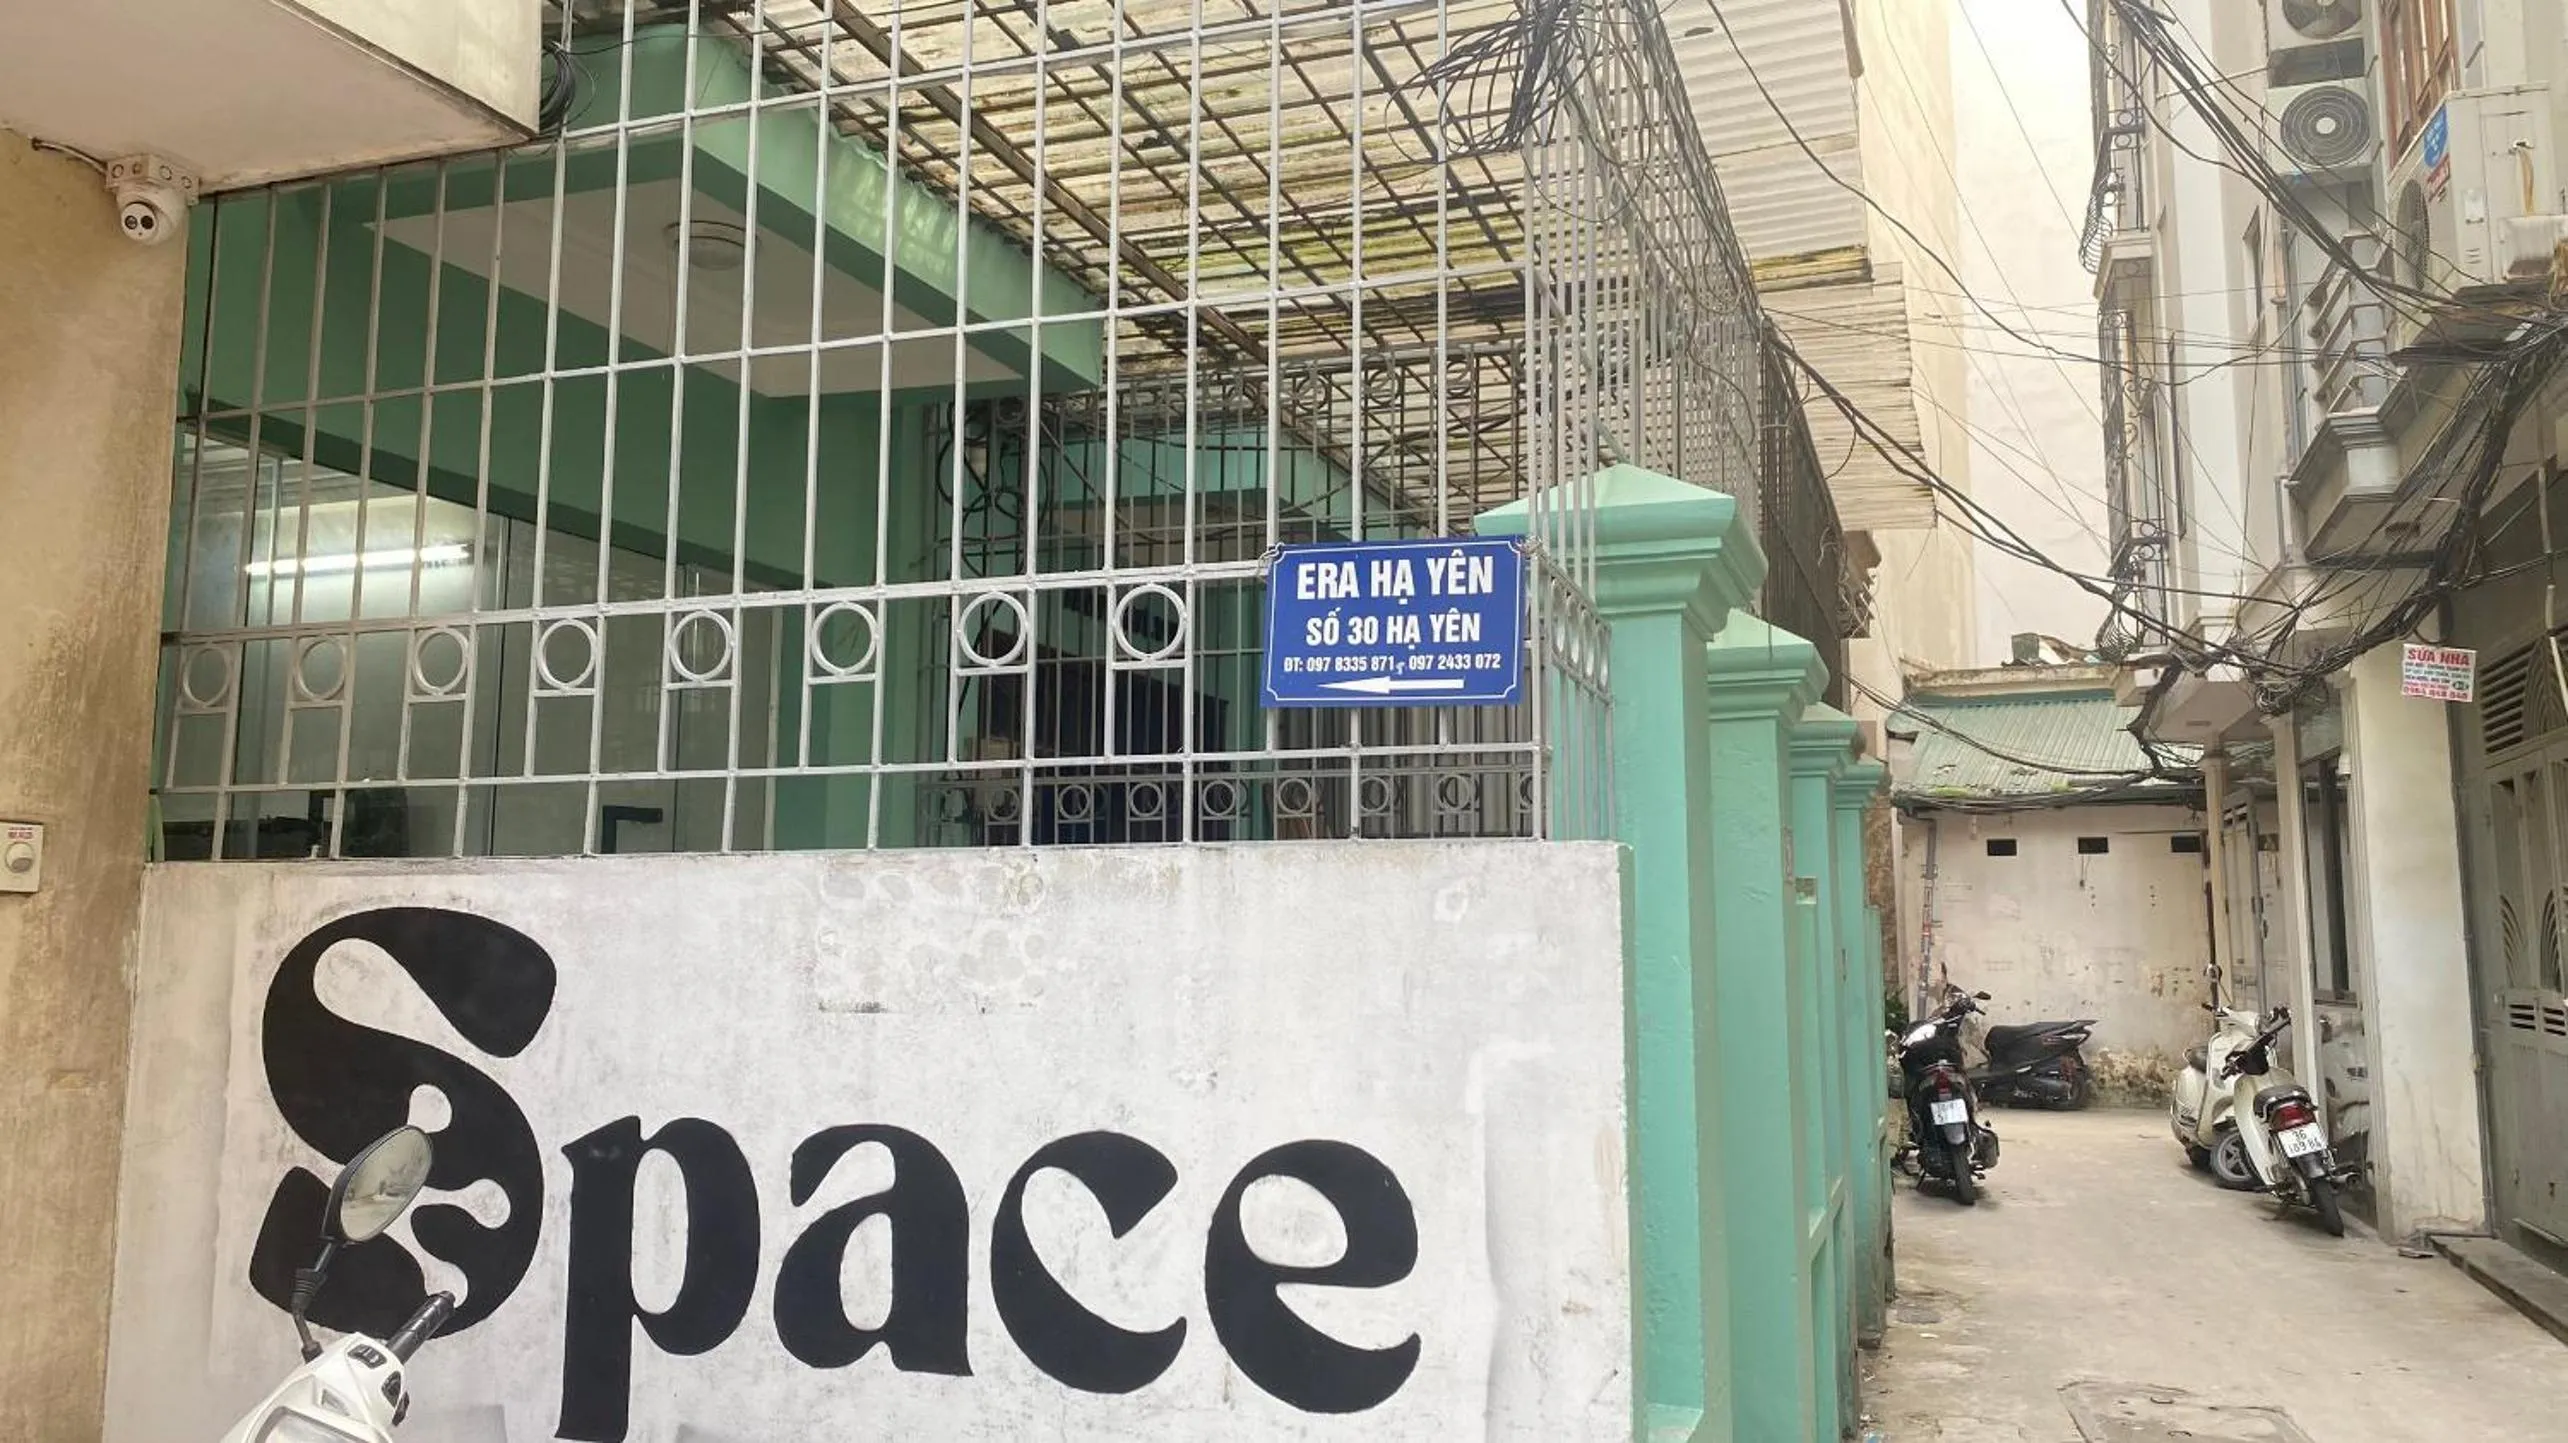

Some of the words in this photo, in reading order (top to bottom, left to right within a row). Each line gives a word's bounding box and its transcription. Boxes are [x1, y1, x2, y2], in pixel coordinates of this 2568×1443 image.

[1297, 561, 1360, 599] ERA
[1371, 559, 1415, 605] HẠ
[1426, 548, 1493, 597] YÊN
[1306, 607, 1341, 646] SỐ
[1347, 616, 1379, 645] 30
[1386, 614, 1421, 650] HẠ
[1429, 607, 1481, 643] YÊN
[1306, 657, 1330, 673] 097
[1335, 655, 1367, 672] 8335
[1371, 655, 1395, 671] 871
[1409, 654, 1433, 670] 097
[1438, 653, 1472, 670] 2433
[1475, 652, 1502, 669] 072
[250, 907, 1421, 1442] Space
